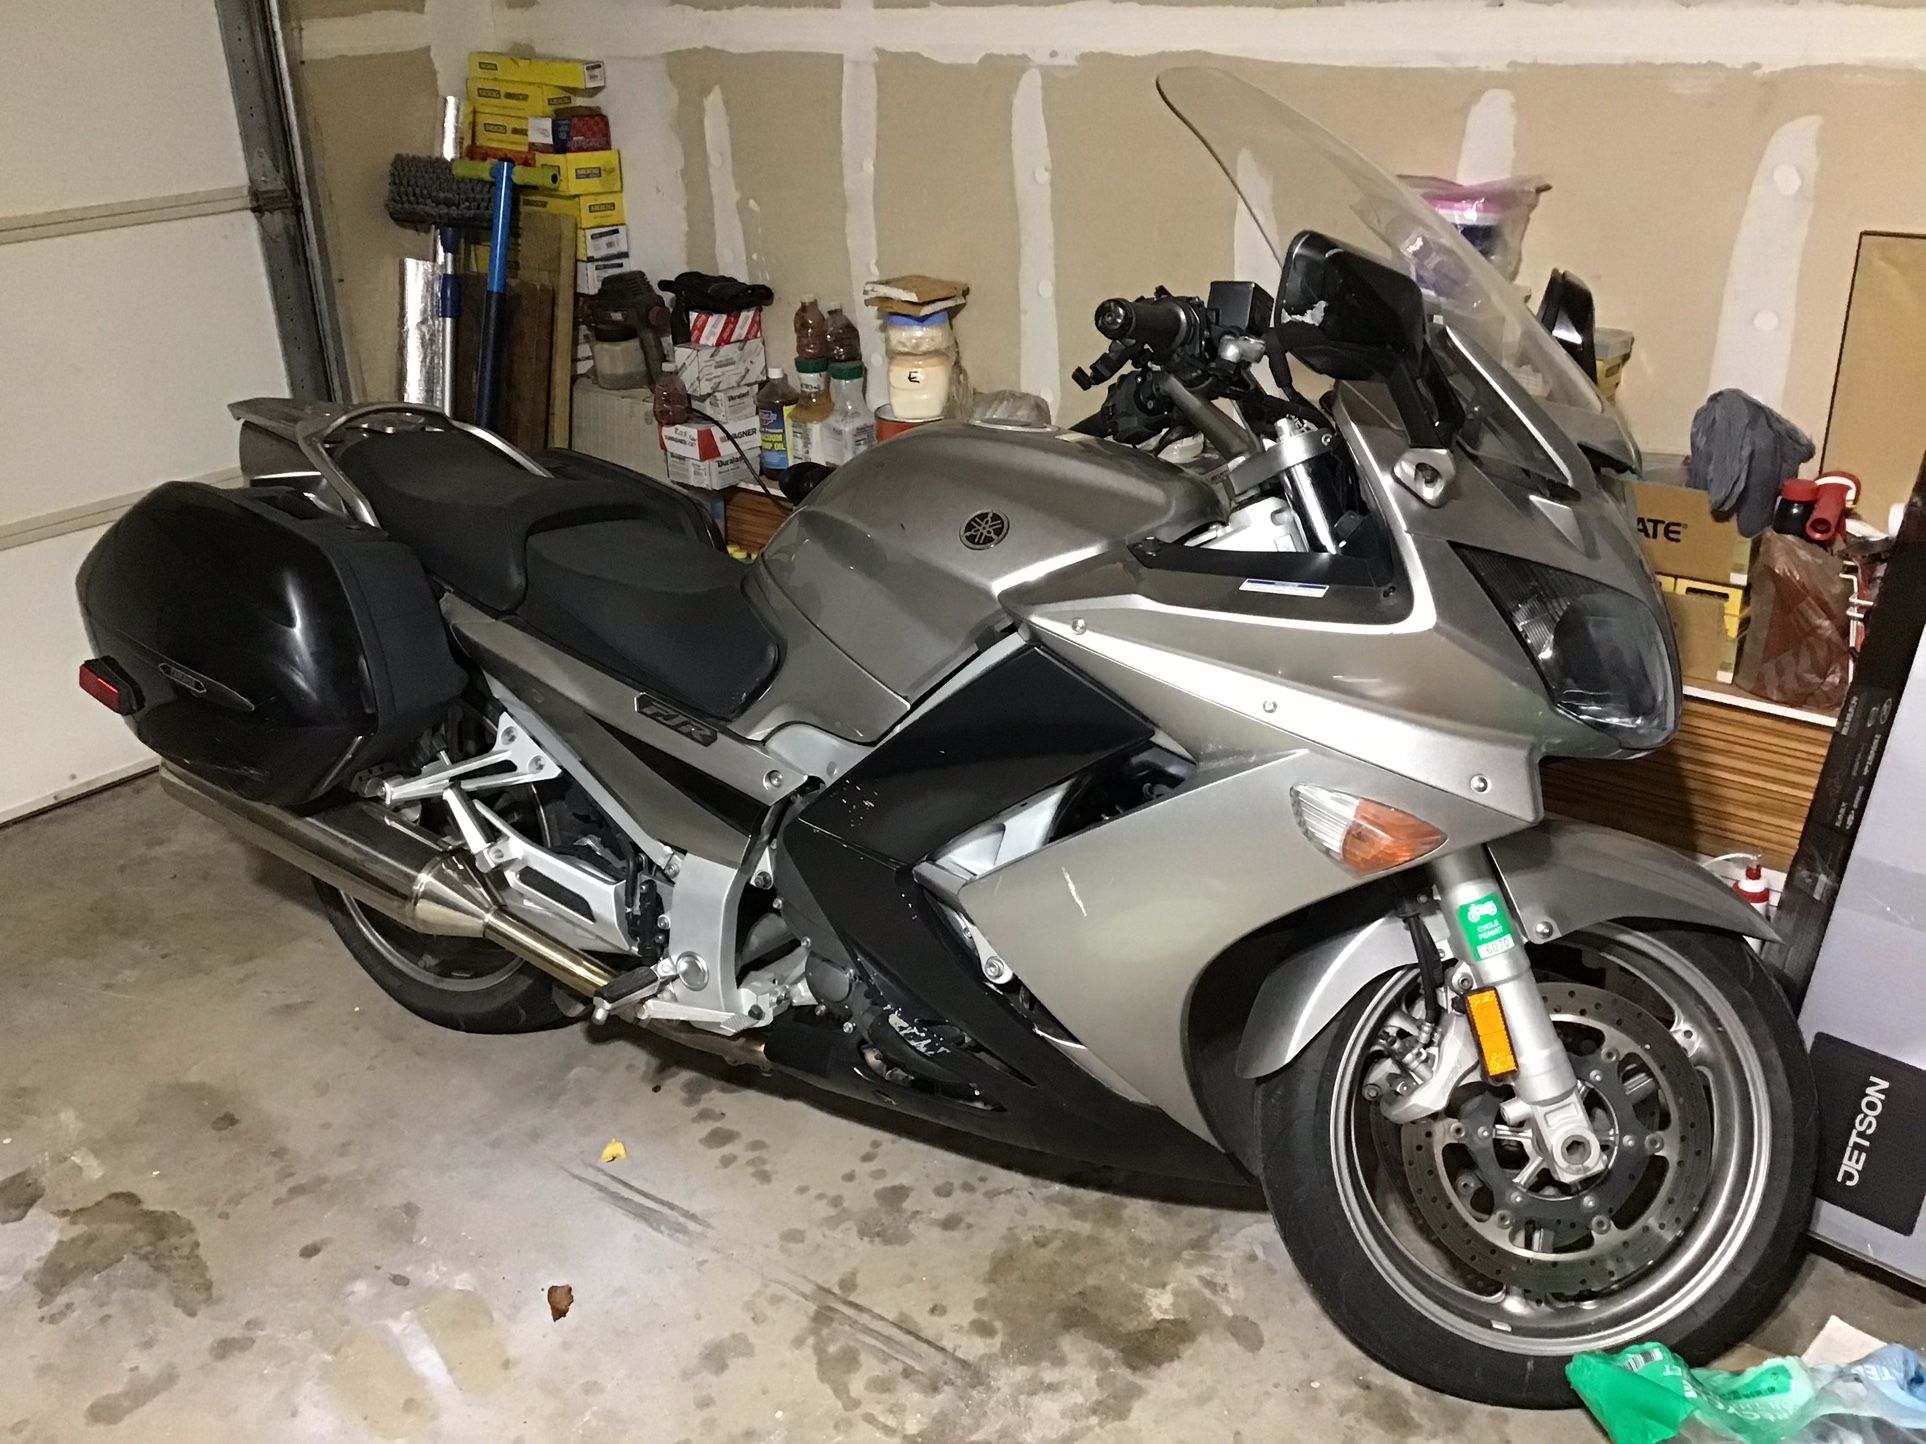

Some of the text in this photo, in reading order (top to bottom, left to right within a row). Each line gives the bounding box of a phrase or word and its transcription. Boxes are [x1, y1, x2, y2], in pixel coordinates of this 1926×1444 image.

[727, 427, 757, 442] AGNER
[1476, 918, 1501, 933] CYCLE
[1477, 925, 1504, 941] PERMIT
[1485, 937, 1510, 954] 6070
[1836, 1075, 1890, 1187] JETSON
